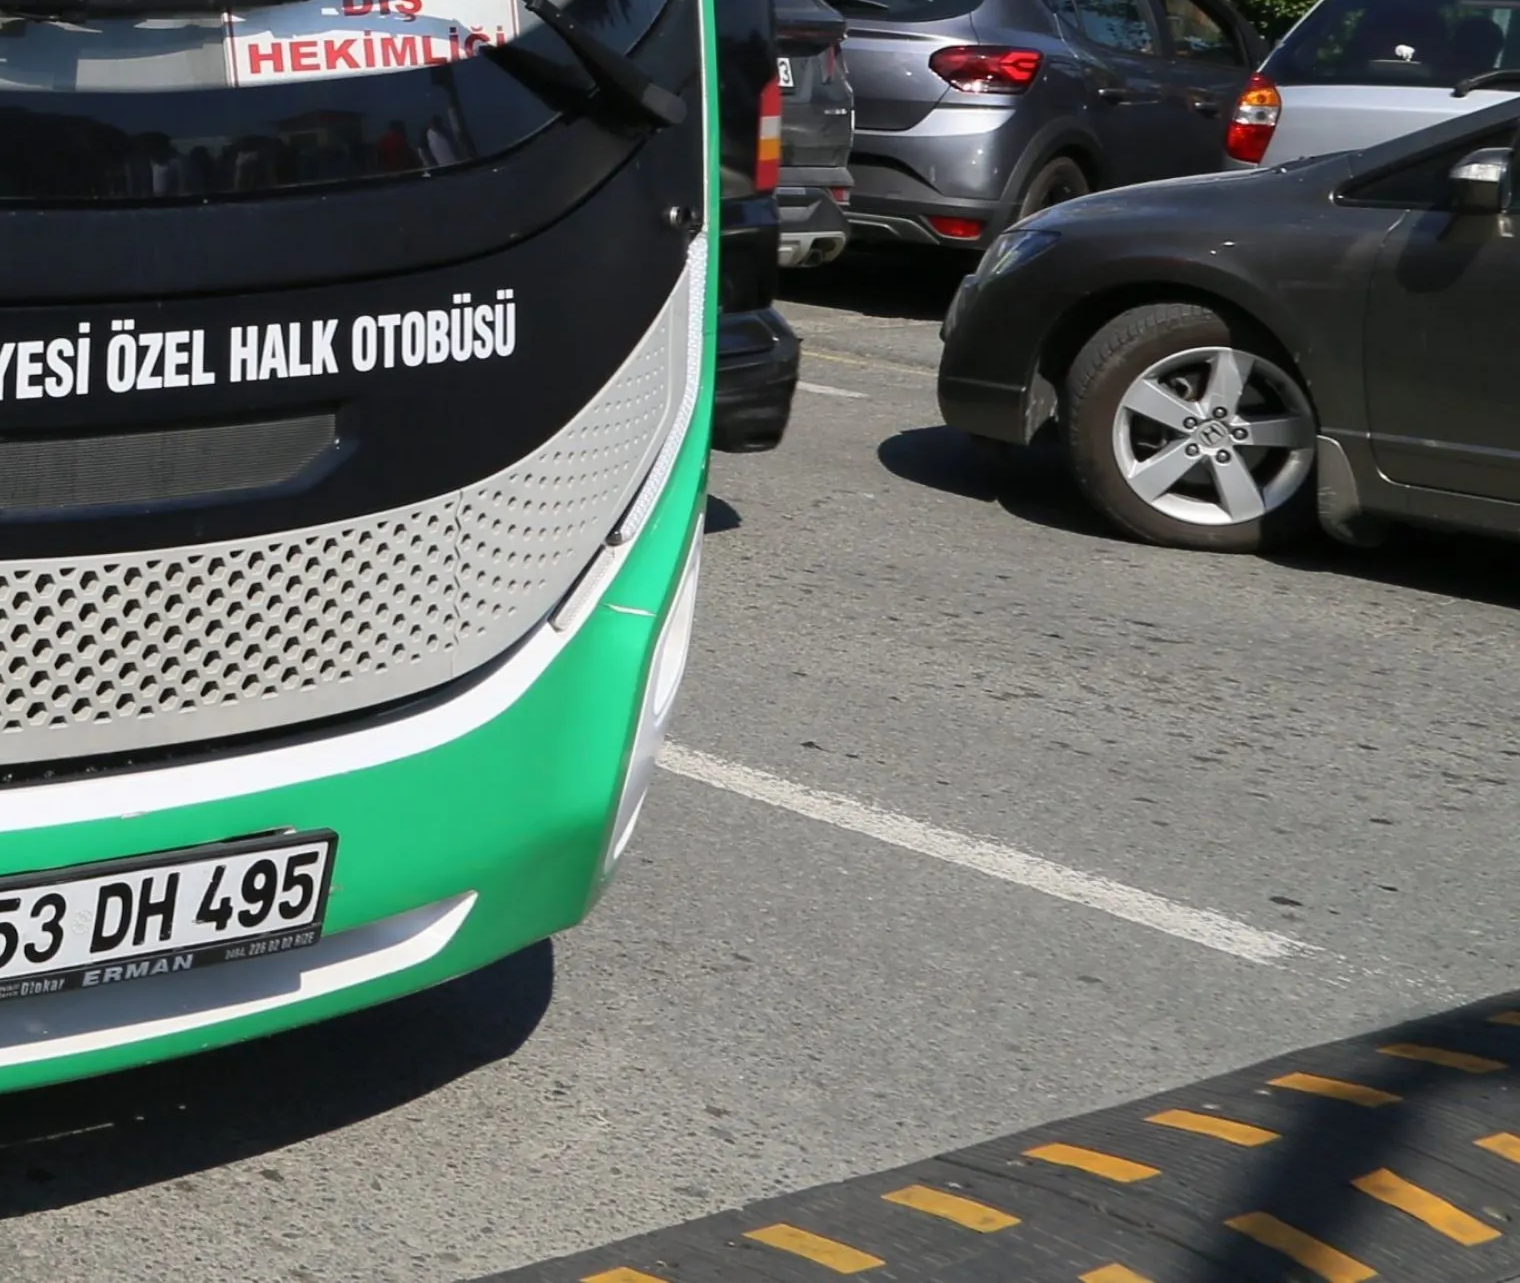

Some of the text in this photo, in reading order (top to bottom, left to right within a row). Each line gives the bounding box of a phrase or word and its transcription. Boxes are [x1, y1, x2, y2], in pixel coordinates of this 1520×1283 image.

[106, 319, 216, 394] ÖZEL
[230, 318, 339, 384] HALK
[351, 289, 518, 373] OTOBÜSÜ
[89, 872, 181, 954] DH
[196, 851, 320, 931] 495
[81, 953, 196, 988] ERMAN
